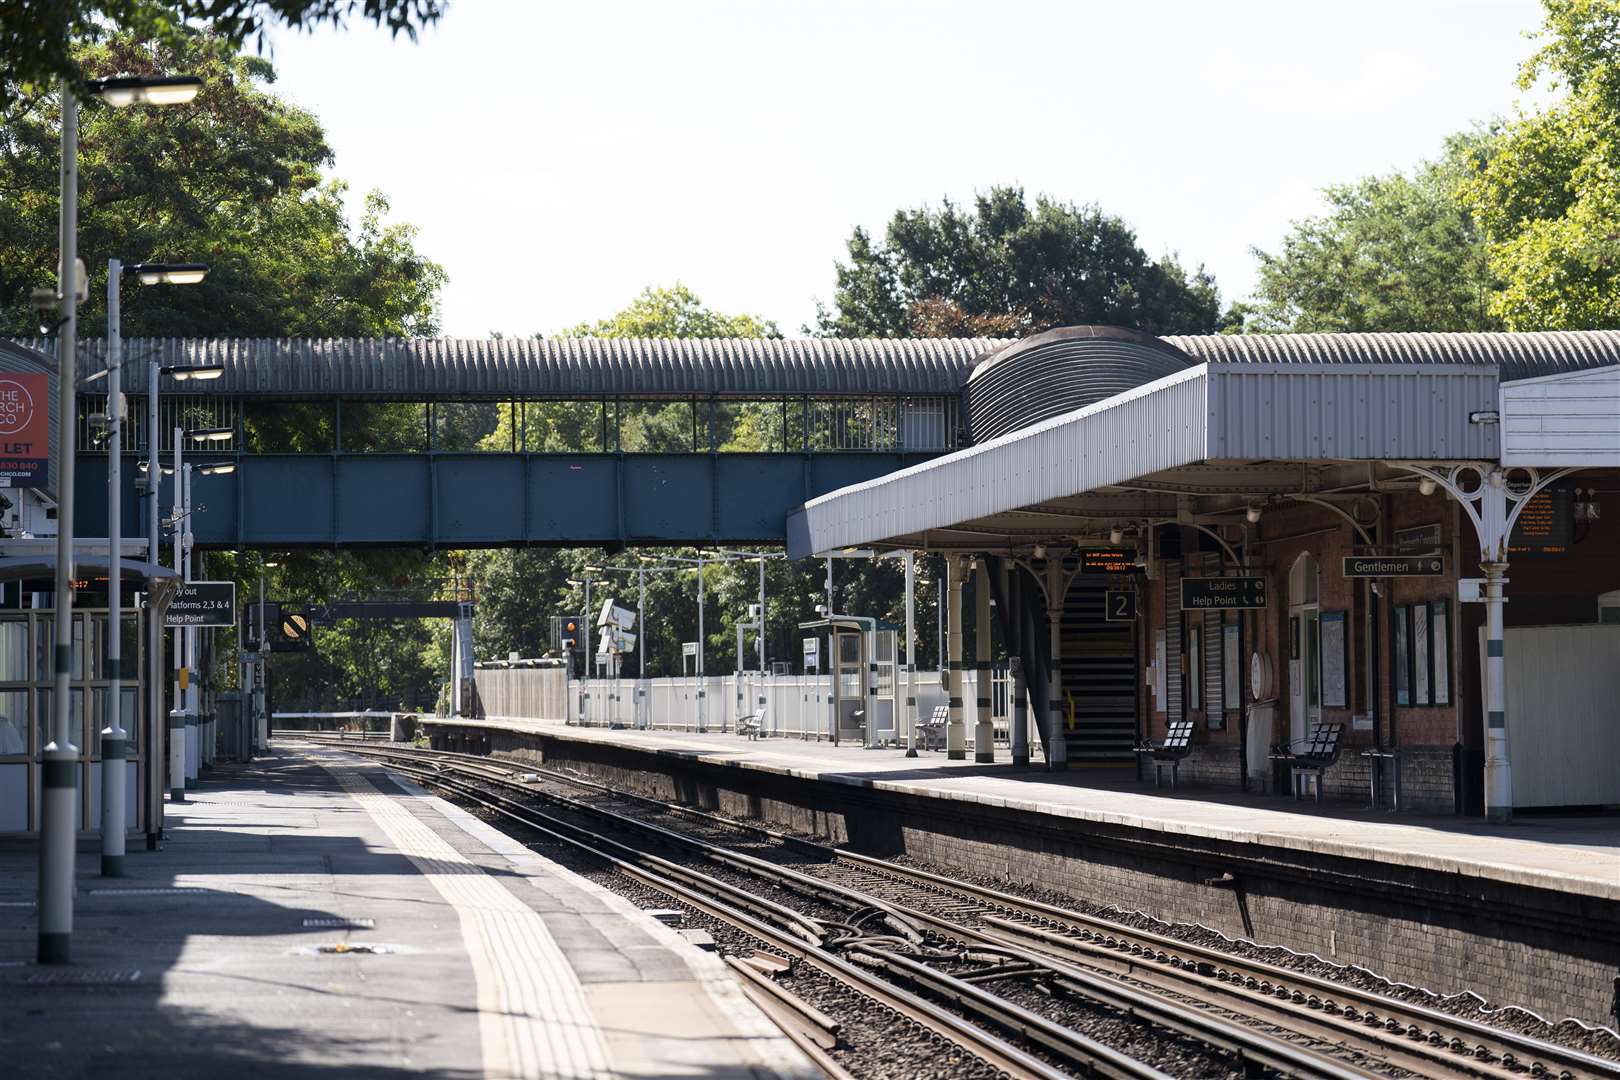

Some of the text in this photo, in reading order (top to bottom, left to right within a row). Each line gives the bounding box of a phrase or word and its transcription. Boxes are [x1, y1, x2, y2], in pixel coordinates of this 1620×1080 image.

[4, 442, 32, 454] LET
[1354, 560, 1409, 572] Gentlemen
[184, 587, 197, 595] out
[1209, 580, 1237, 591] Ladies
[202, 600, 215, 610] 2,3
[216, 600, 224, 609] &
[224, 600, 230, 609] 4
[1115, 595, 1128, 616] 2
[1192, 595, 1237, 607] Help Point
[166, 614, 204, 625] Help Point
